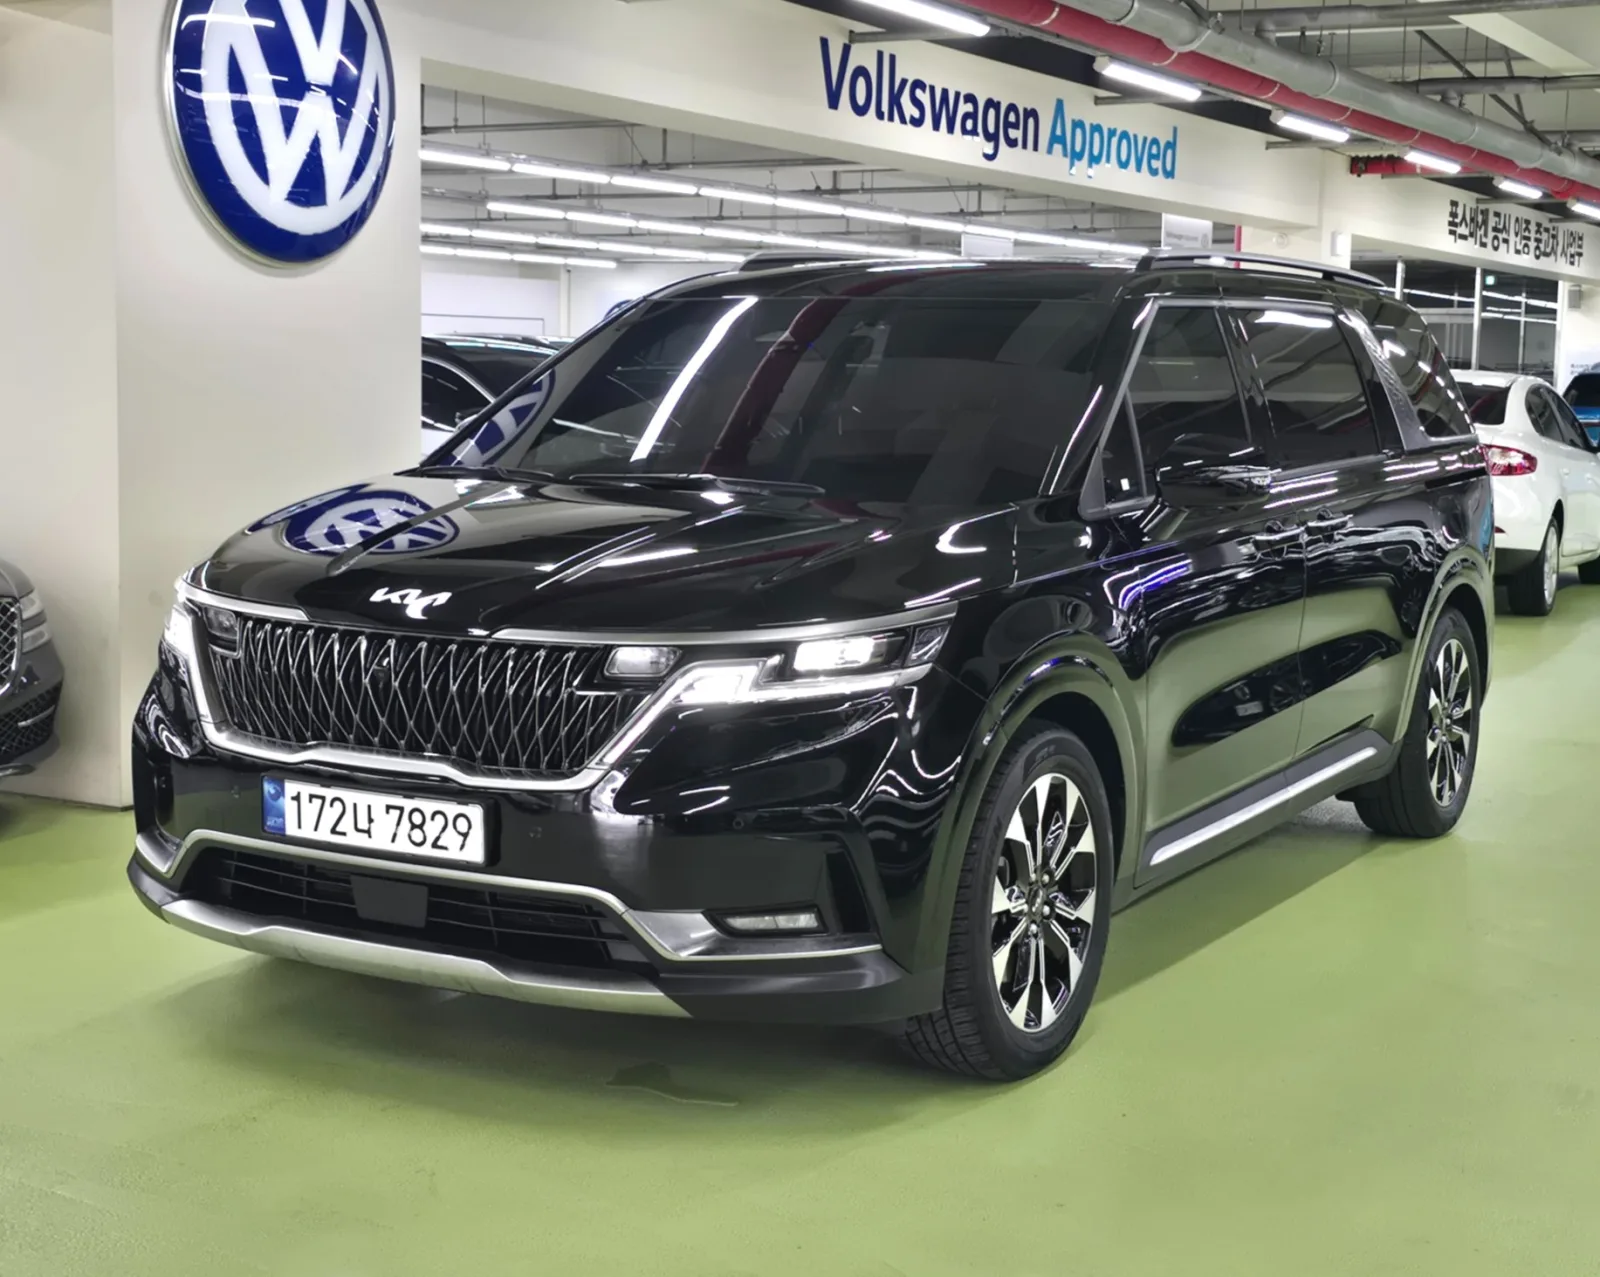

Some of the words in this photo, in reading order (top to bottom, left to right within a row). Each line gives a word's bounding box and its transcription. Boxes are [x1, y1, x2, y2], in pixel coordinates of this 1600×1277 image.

[819, 36, 1040, 161] Volkswagen
[1046, 98, 1178, 179] Approved
[1448, 199, 1490, 248] 폭스바겐
[1491, 211, 1511, 254] 공식
[1514, 216, 1532, 255] 인증
[1533, 222, 1559, 262] 중고차
[1560, 229, 1584, 267] 사업부
[290, 791, 375, 839] 172나
[385, 804, 473, 851] 7829
